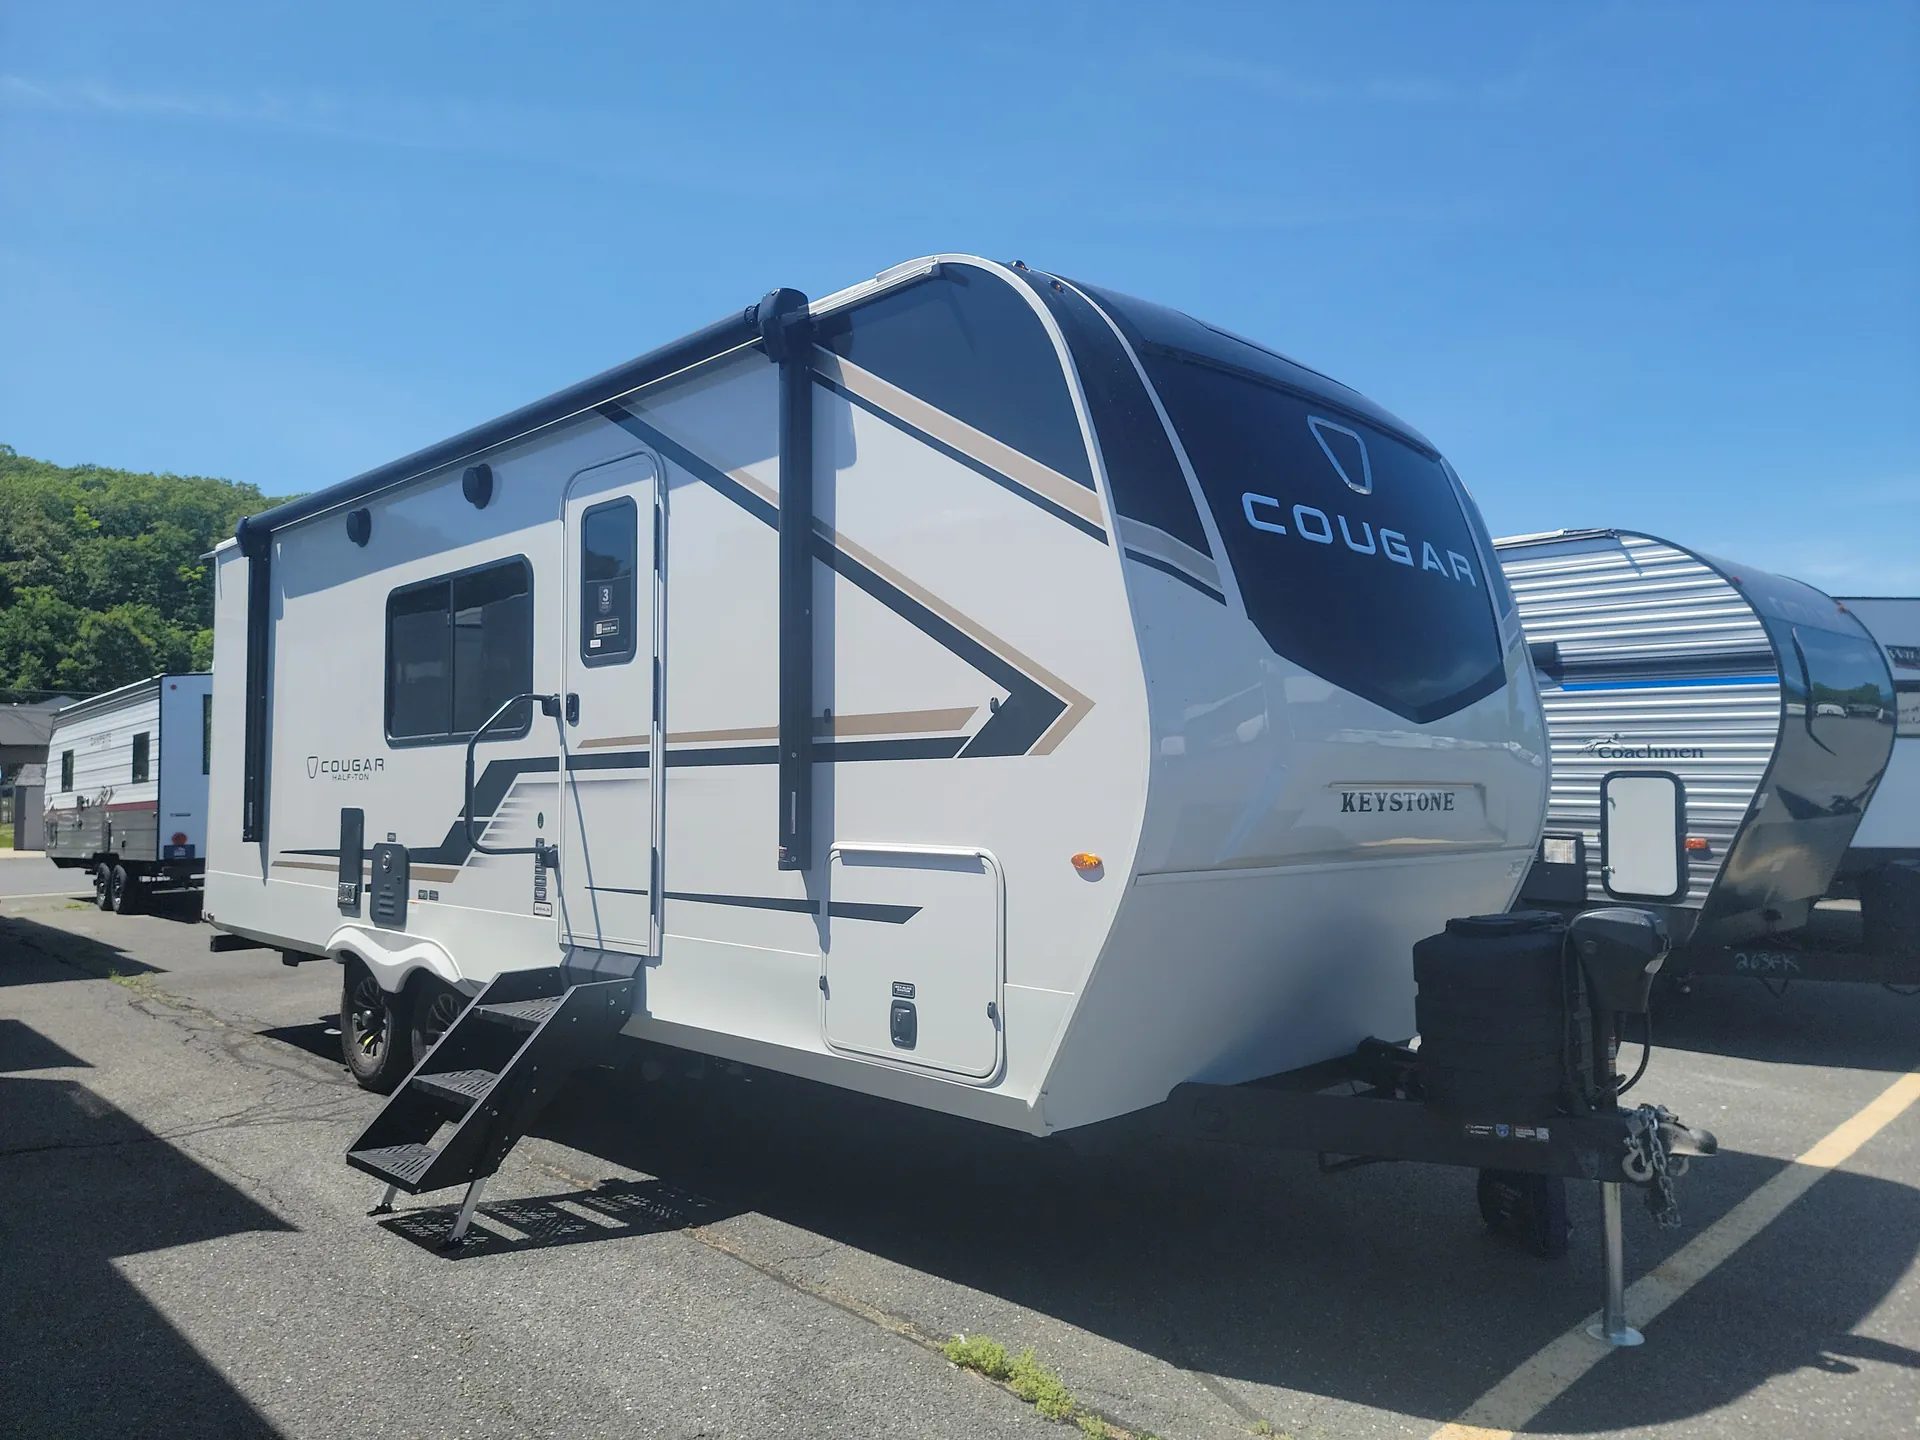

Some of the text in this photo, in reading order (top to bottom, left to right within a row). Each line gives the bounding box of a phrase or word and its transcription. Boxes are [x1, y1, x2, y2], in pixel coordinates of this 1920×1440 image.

[1241, 492, 1477, 587] COUGAR
[602, 589, 609, 601] 3
[1597, 744, 1704, 759] Coachmen
[321, 758, 385, 773] COUGAR
[332, 773, 370, 781] HALF-TON
[1340, 792, 1456, 812] KEYSTONE
